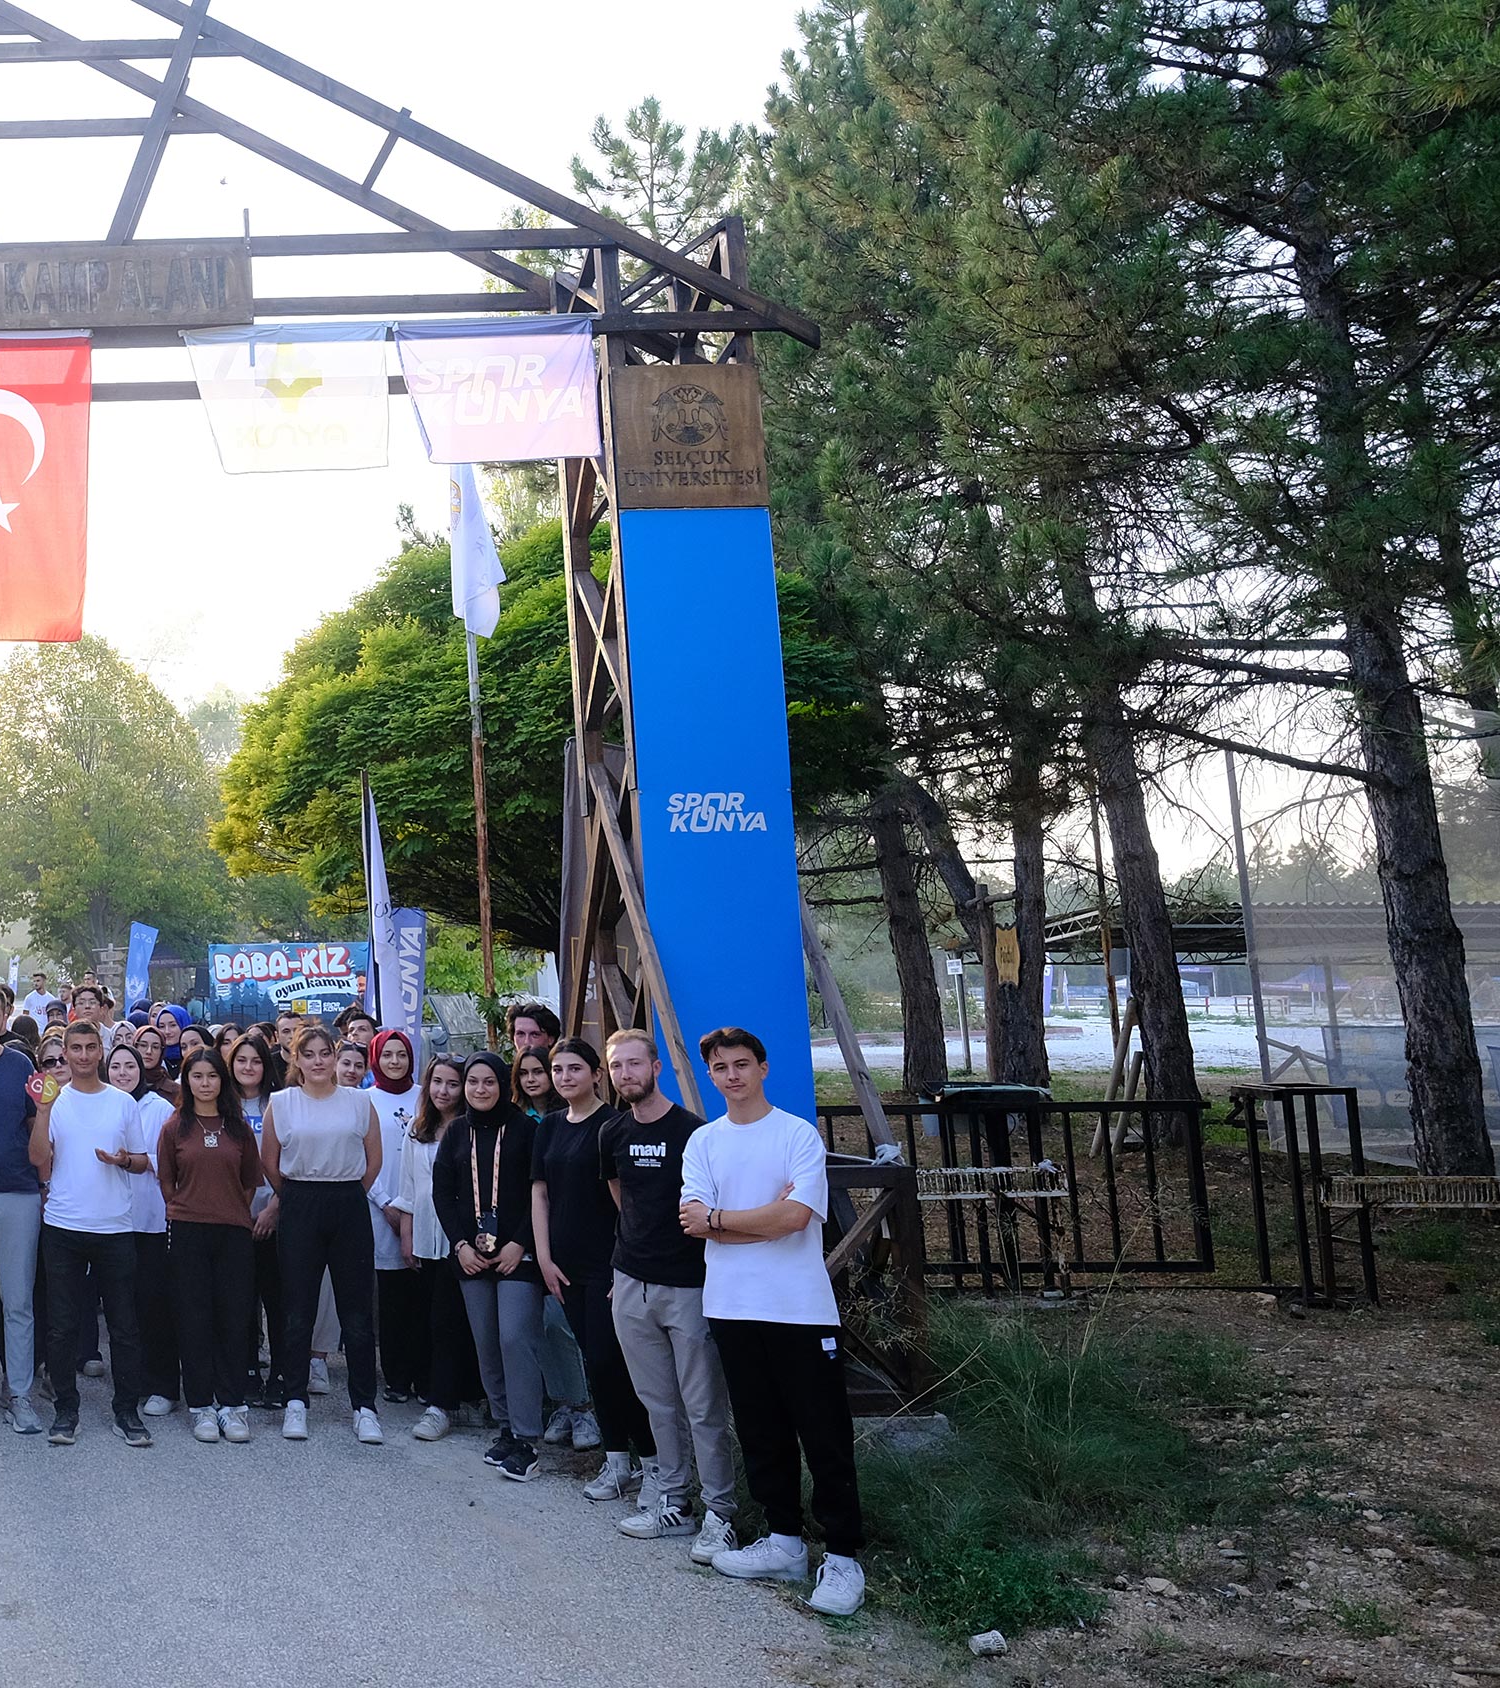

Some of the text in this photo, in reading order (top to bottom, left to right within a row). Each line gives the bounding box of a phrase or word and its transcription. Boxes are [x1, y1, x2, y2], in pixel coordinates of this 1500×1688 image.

[4, 259, 111, 315] KAMP
[117, 256, 228, 313] ALANI
[415, 354, 547, 394] SPOR
[653, 450, 732, 468] SELÇUK
[624, 467, 762, 488] ÜNİVERSİTESİ
[666, 792, 746, 814] SPOR
[669, 806, 768, 833] KONYA
[275, 979, 305, 999] oyun
[629, 1141, 667, 1157] mavi
